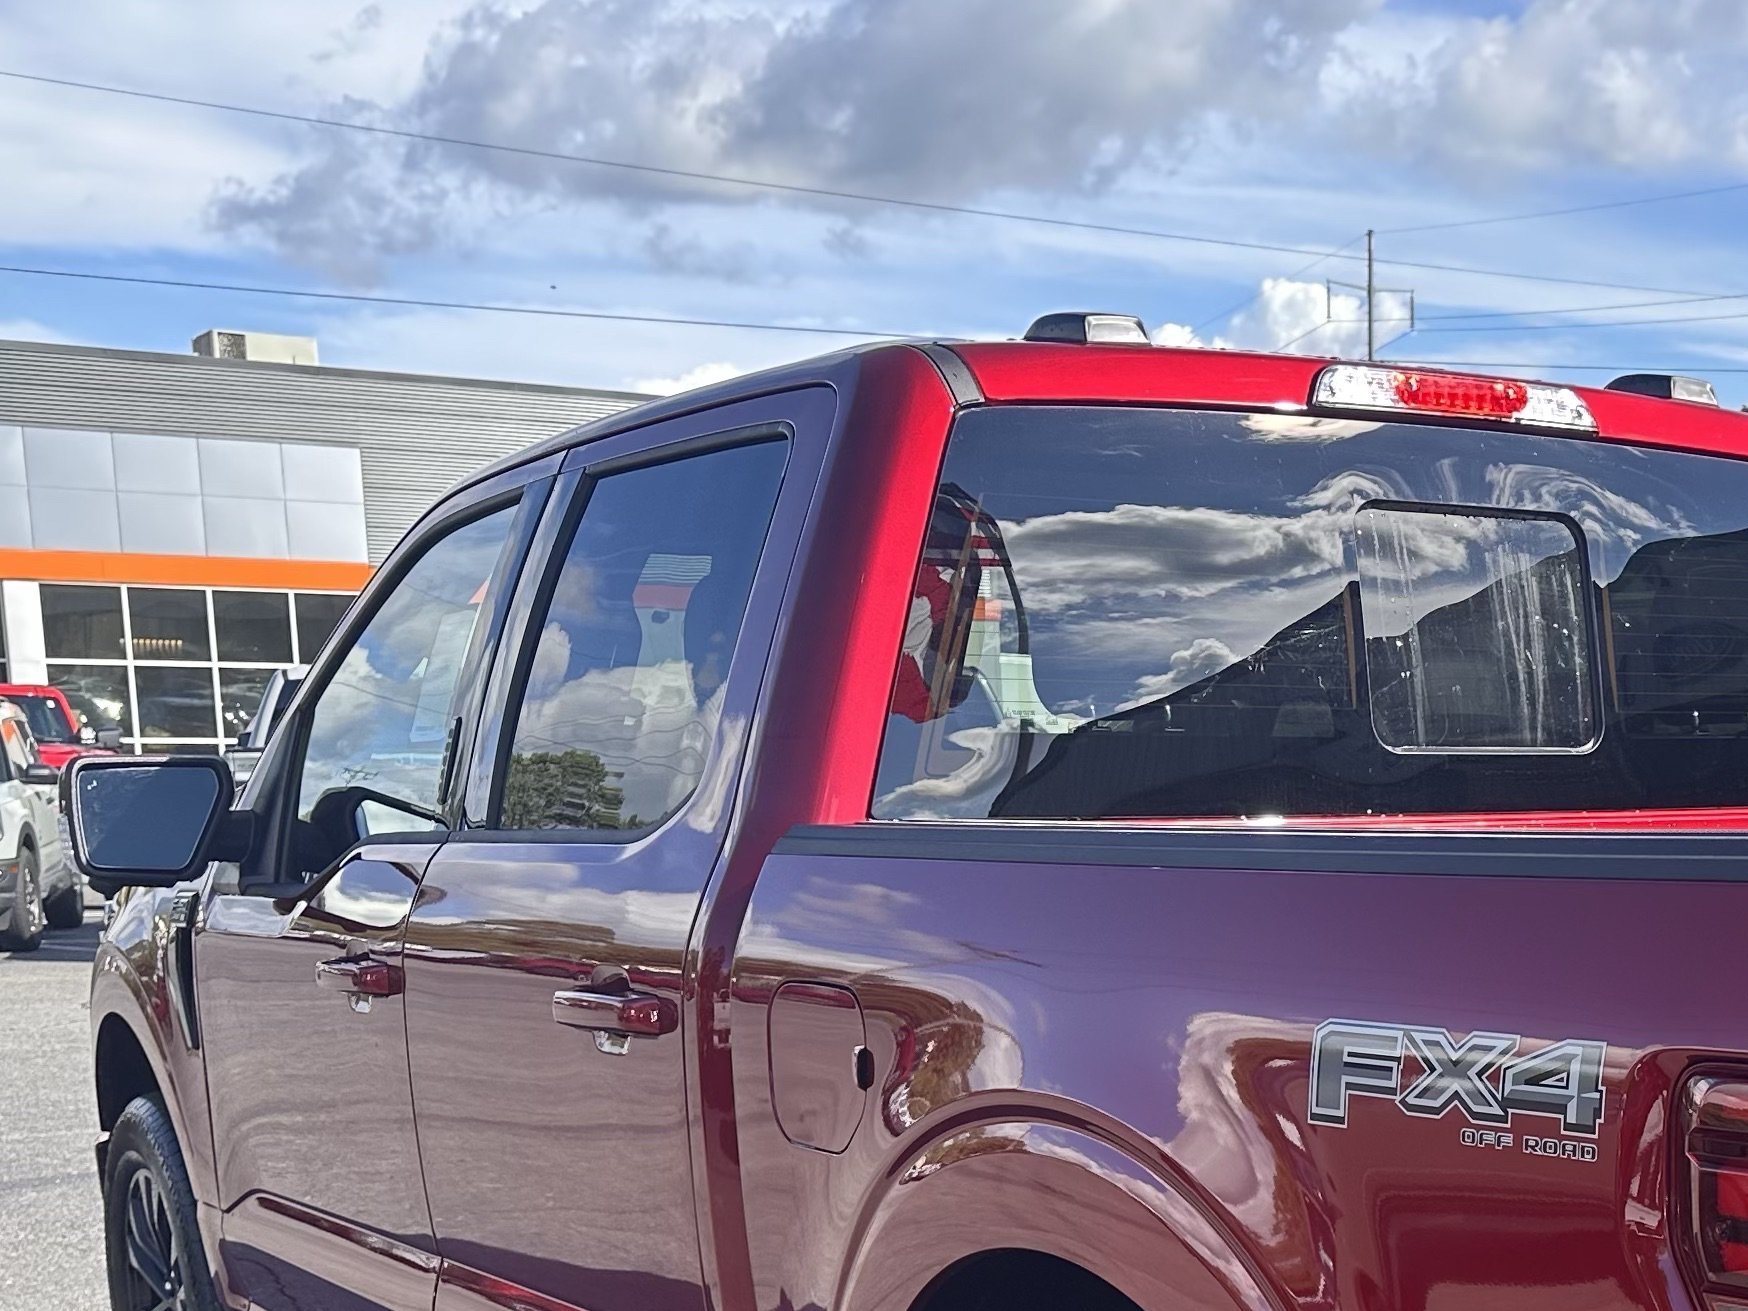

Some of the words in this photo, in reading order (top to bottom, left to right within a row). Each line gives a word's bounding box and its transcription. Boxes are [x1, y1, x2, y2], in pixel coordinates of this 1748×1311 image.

[1308, 1018, 1607, 1138] FX4
[1460, 1128, 1513, 1150] OFF
[1523, 1136, 1599, 1163] ROAD
